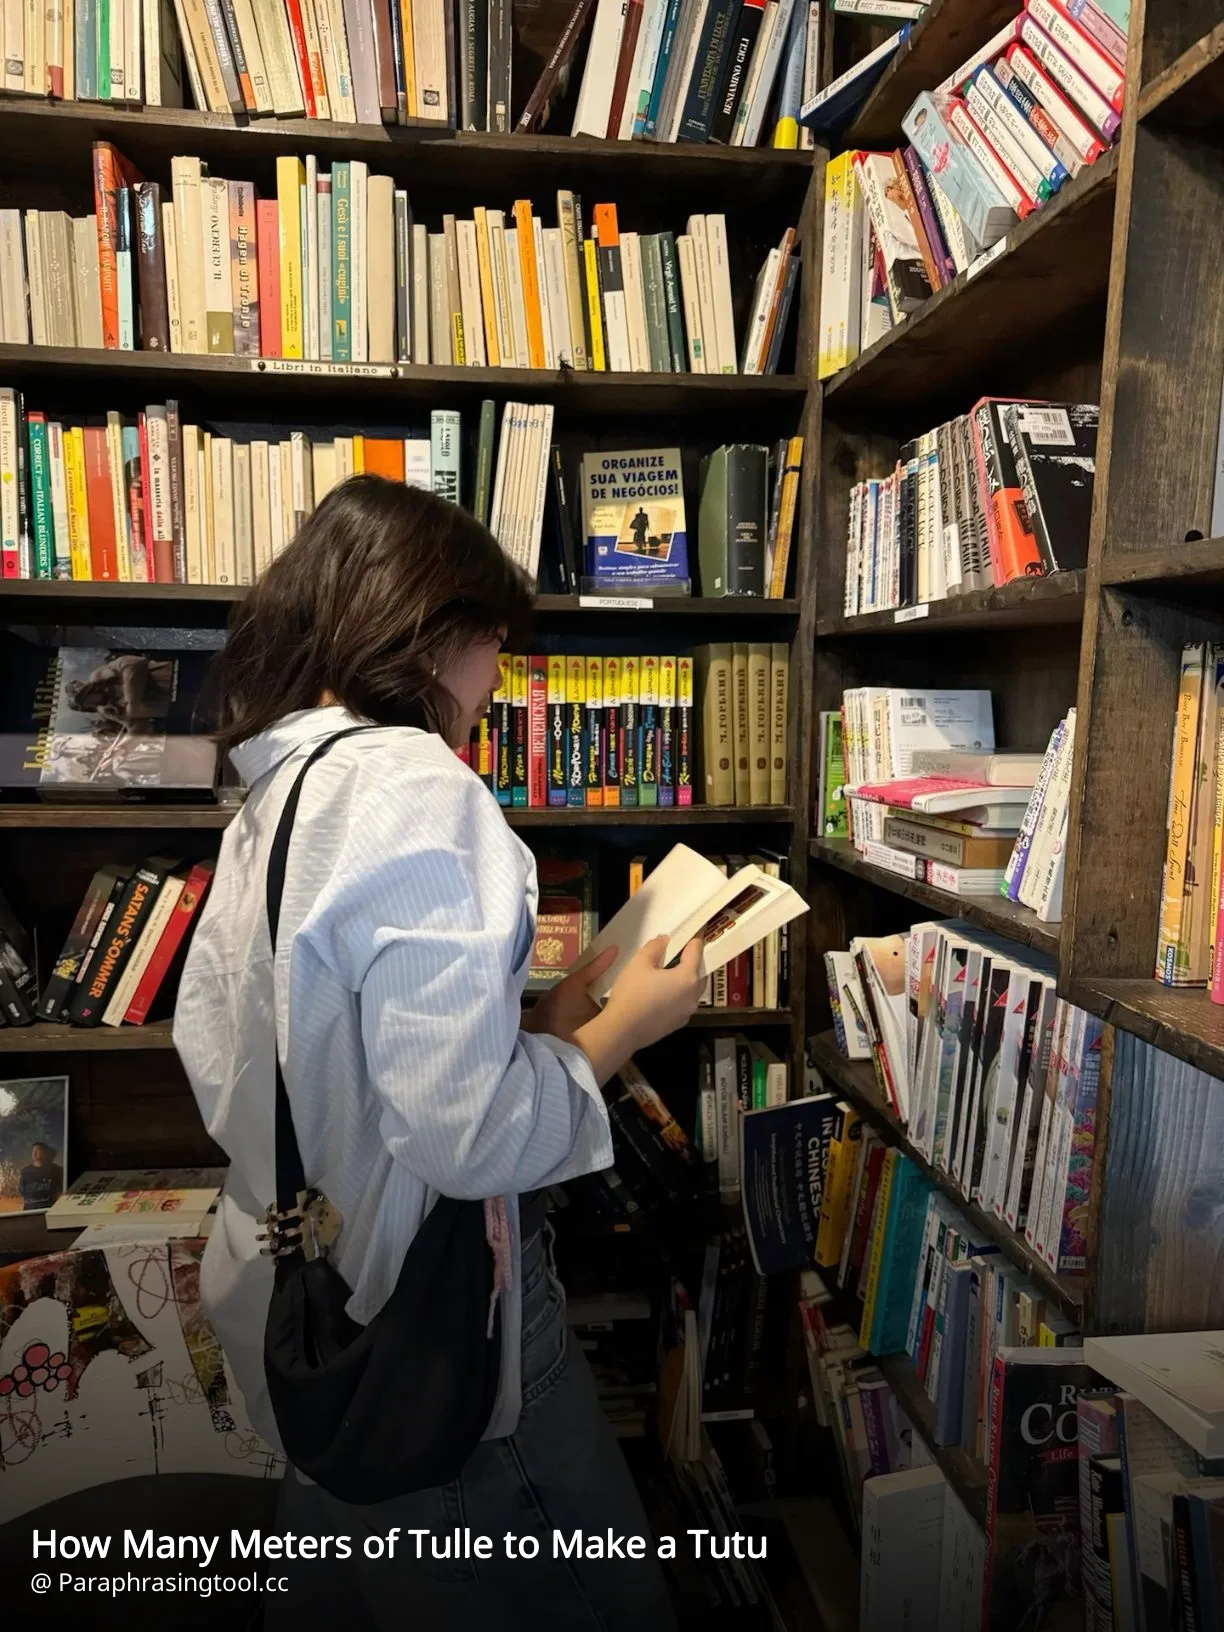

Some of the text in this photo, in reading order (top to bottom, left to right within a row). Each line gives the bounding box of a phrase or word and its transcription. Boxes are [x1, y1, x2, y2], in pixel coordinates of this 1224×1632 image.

[467, 42, 476, 72] SEGRETI
[547, 54, 560, 71] ROMA
[719, 36, 751, 115] BENIAMINO GIGLI
[467, 81, 476, 103] ROMA
[337, 199, 349, 223] Gesù
[210, 215, 222, 266] GUERCINO
[338, 239, 347, 261] suoi
[213, 270, 222, 280] IL
[237, 225, 251, 329] Hagen di Tronje
[336, 263, 348, 305] «cugini»
[272, 361, 378, 375] Libri in Italiano
[1, 395, 12, 468] Fluent Forever
[154, 467, 161, 475] la
[590, 470, 677, 485] SUA VIAGEM
[602, 456, 664, 469] ORGANIZE
[33, 439, 48, 567] CORRECT your ITALIAN BLUNDERS
[154, 477, 163, 508] masseria
[592, 484, 678, 499] DE NEGÓCIOS!
[156, 510, 164, 528] delle
[961, 518, 981, 575] INFAMY
[532, 689, 546, 753] ВЕДЕНСКАЯ
[24, 725, 55, 771] John
[1173, 790, 1187, 821] Time
[1167, 850, 1182, 881] Spent
[116, 882, 150, 939] SATANS
[88, 936, 126, 999] SOMMER
[1164, 947, 1175, 983] KOSMOS
[772, 1175, 781, 1208] Traditional
[807, 1137, 821, 1219] CHINESE
[1051, 1448, 1073, 1460] Life
[984, 1467, 996, 1525] COWBOY
